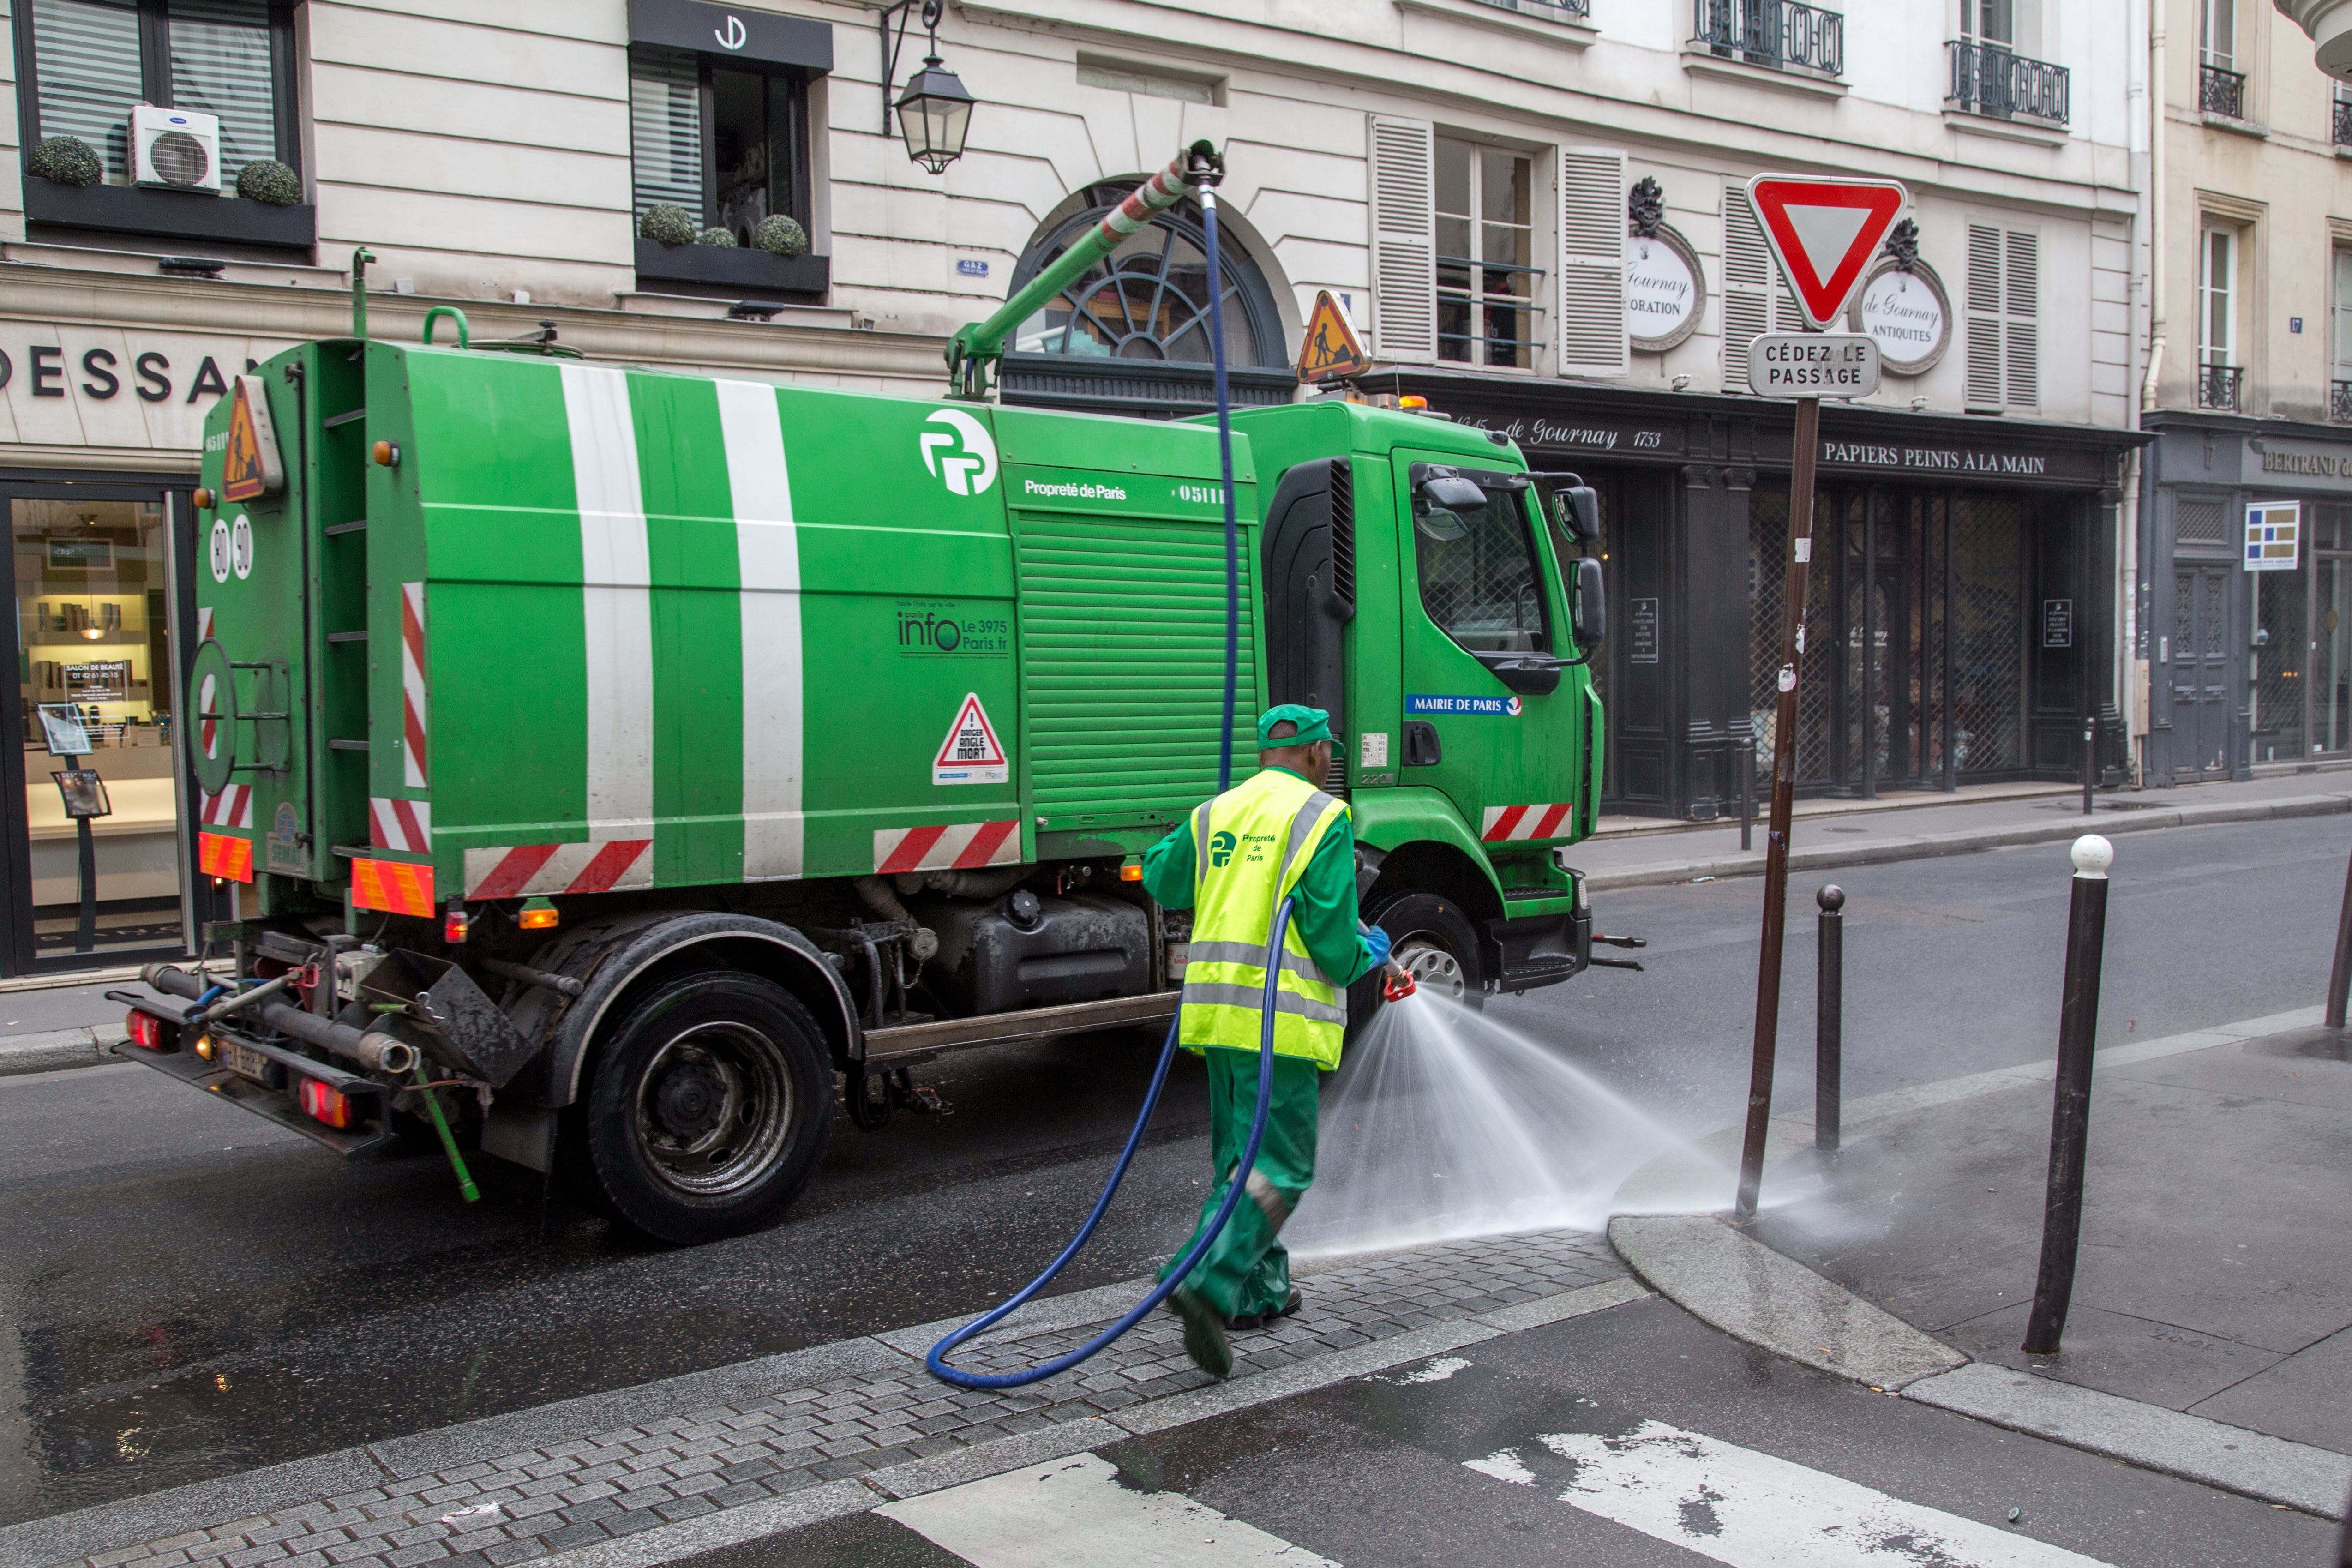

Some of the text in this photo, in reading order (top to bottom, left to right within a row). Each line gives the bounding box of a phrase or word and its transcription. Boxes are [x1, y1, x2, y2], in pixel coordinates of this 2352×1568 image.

[715, 15, 746, 50] JD
[964, 261, 982, 270] GAZ
[1631, 299, 1680, 315] ORATION
[1865, 294, 1939, 329] de Gournay
[1872, 324, 1931, 342] ANTIQUITES
[2292, 319, 2300, 332] 17
[1766, 343, 1865, 361] CÉDEZ LE
[0, 345, 259, 406] ESSA
[1770, 368, 1860, 384] PASSAGE
[1506, 418, 1524, 438] de
[1530, 419, 1617, 450] Gournay
[1634, 431, 1661, 448] 1753
[1824, 443, 2045, 474] PAPIERS PEINTS À LA MAIN
[2204, 445, 2214, 469] 17
[2263, 451, 2338, 475] BERTRAND
[1025, 480, 1126, 500] Propreté de Paris
[897, 611, 961, 652] info
[962, 620, 1007, 634] Le 3975
[963, 637, 1008, 650] Paris.fr
[1415, 698, 1501, 711] MAIRIE DE PARIS
[959, 737, 984, 747] ANGLE
[957, 747, 986, 760] MORT
[1242, 834, 1275, 843] Propreté
